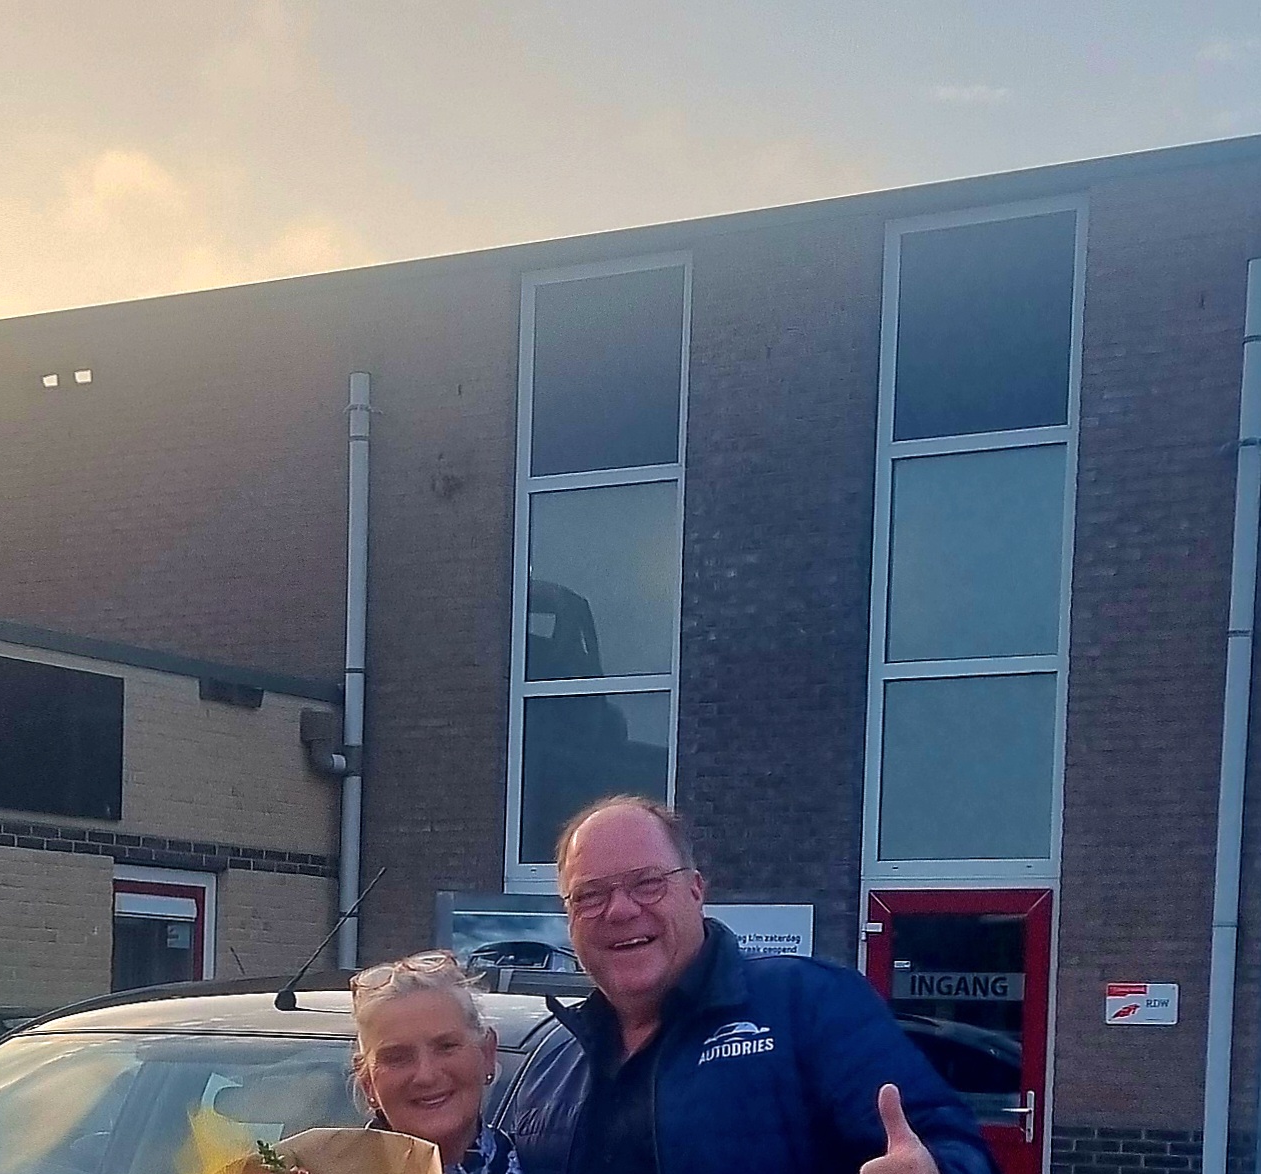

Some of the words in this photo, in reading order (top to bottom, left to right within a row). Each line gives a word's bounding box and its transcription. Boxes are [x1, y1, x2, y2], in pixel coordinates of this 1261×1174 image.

[764, 934, 801, 944] zaterdag
[910, 975, 1009, 997] INGANG
[1145, 999, 1170, 1008] RDW
[698, 1038, 774, 1066] AUTODRIES
